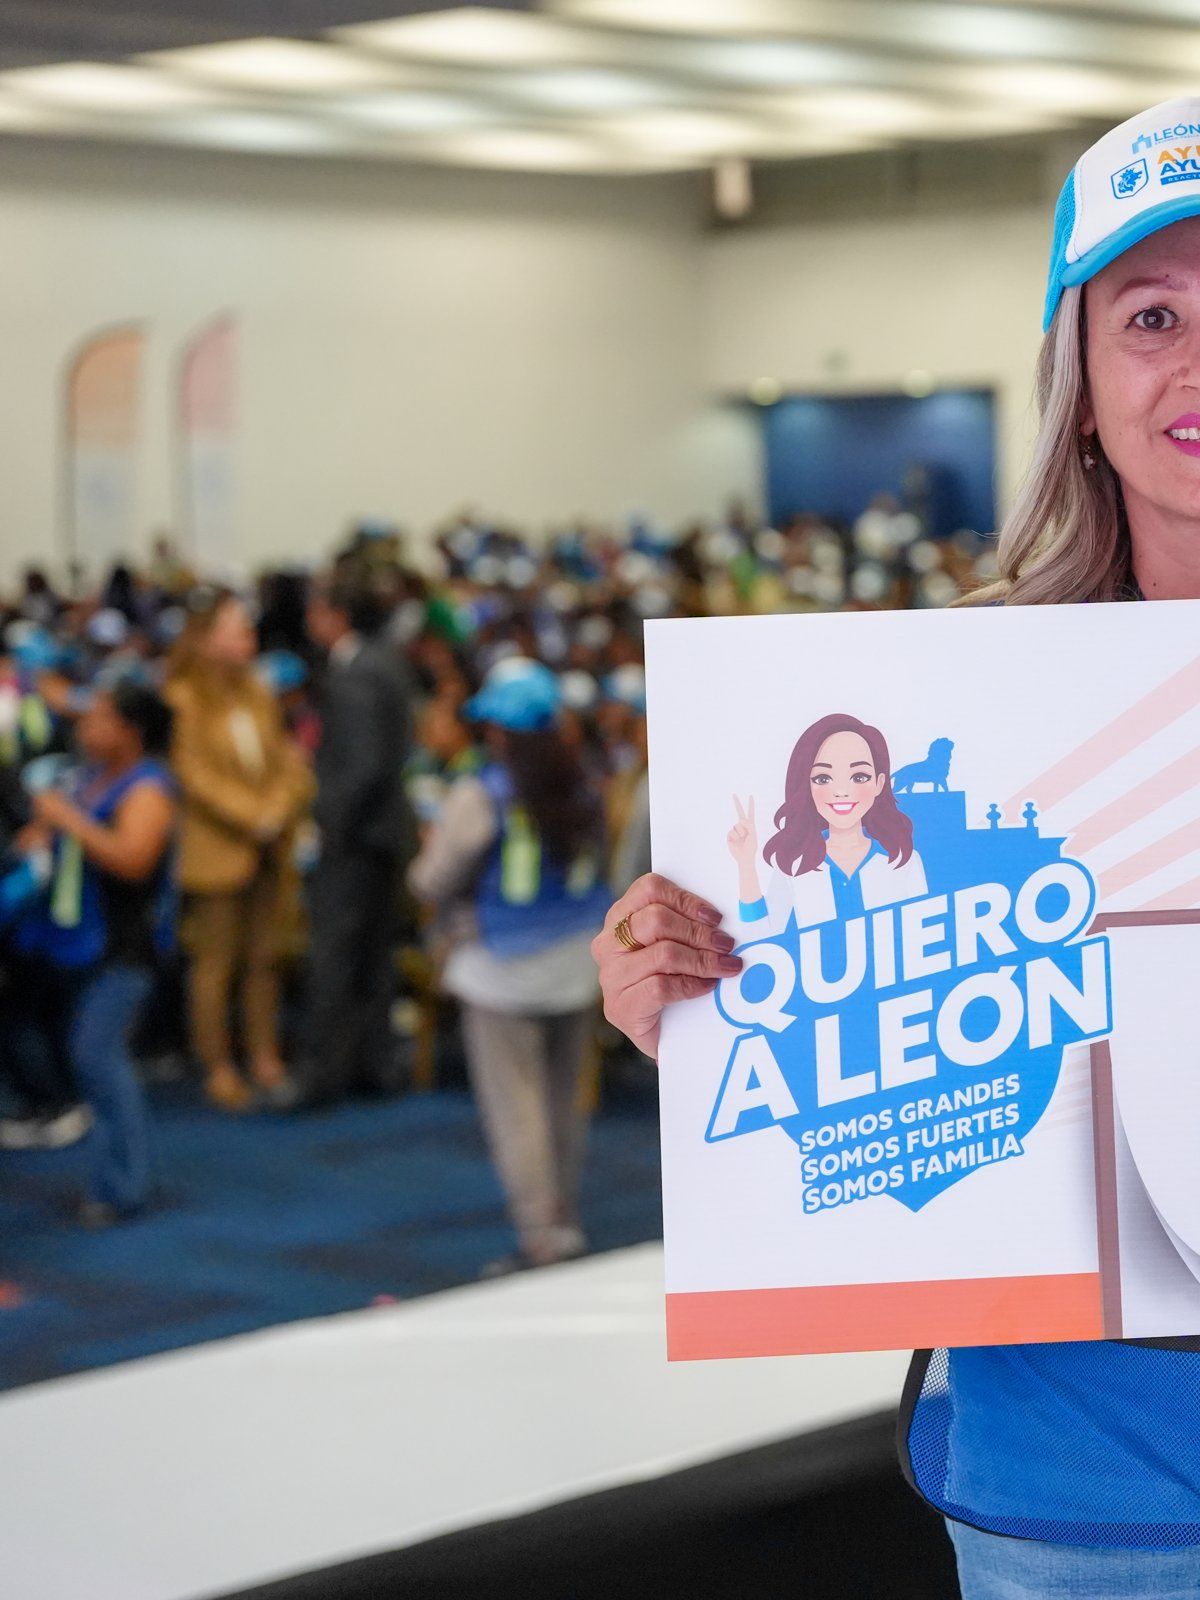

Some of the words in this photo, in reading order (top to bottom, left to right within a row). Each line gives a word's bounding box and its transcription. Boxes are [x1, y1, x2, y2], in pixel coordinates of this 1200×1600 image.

[719, 862, 1091, 1033] QUIERO
[710, 1034, 800, 1139] A
[814, 941, 1109, 1108] LEÓN
[801, 1109, 893, 1152] SOMOS
[899, 1073, 1020, 1124] GRANDES
[803, 1138, 900, 1182] SOMOS
[906, 1103, 1020, 1153] FUERTES
[804, 1165, 905, 1212] SOMOS
[911, 1134, 1021, 1183] FAMILIA
